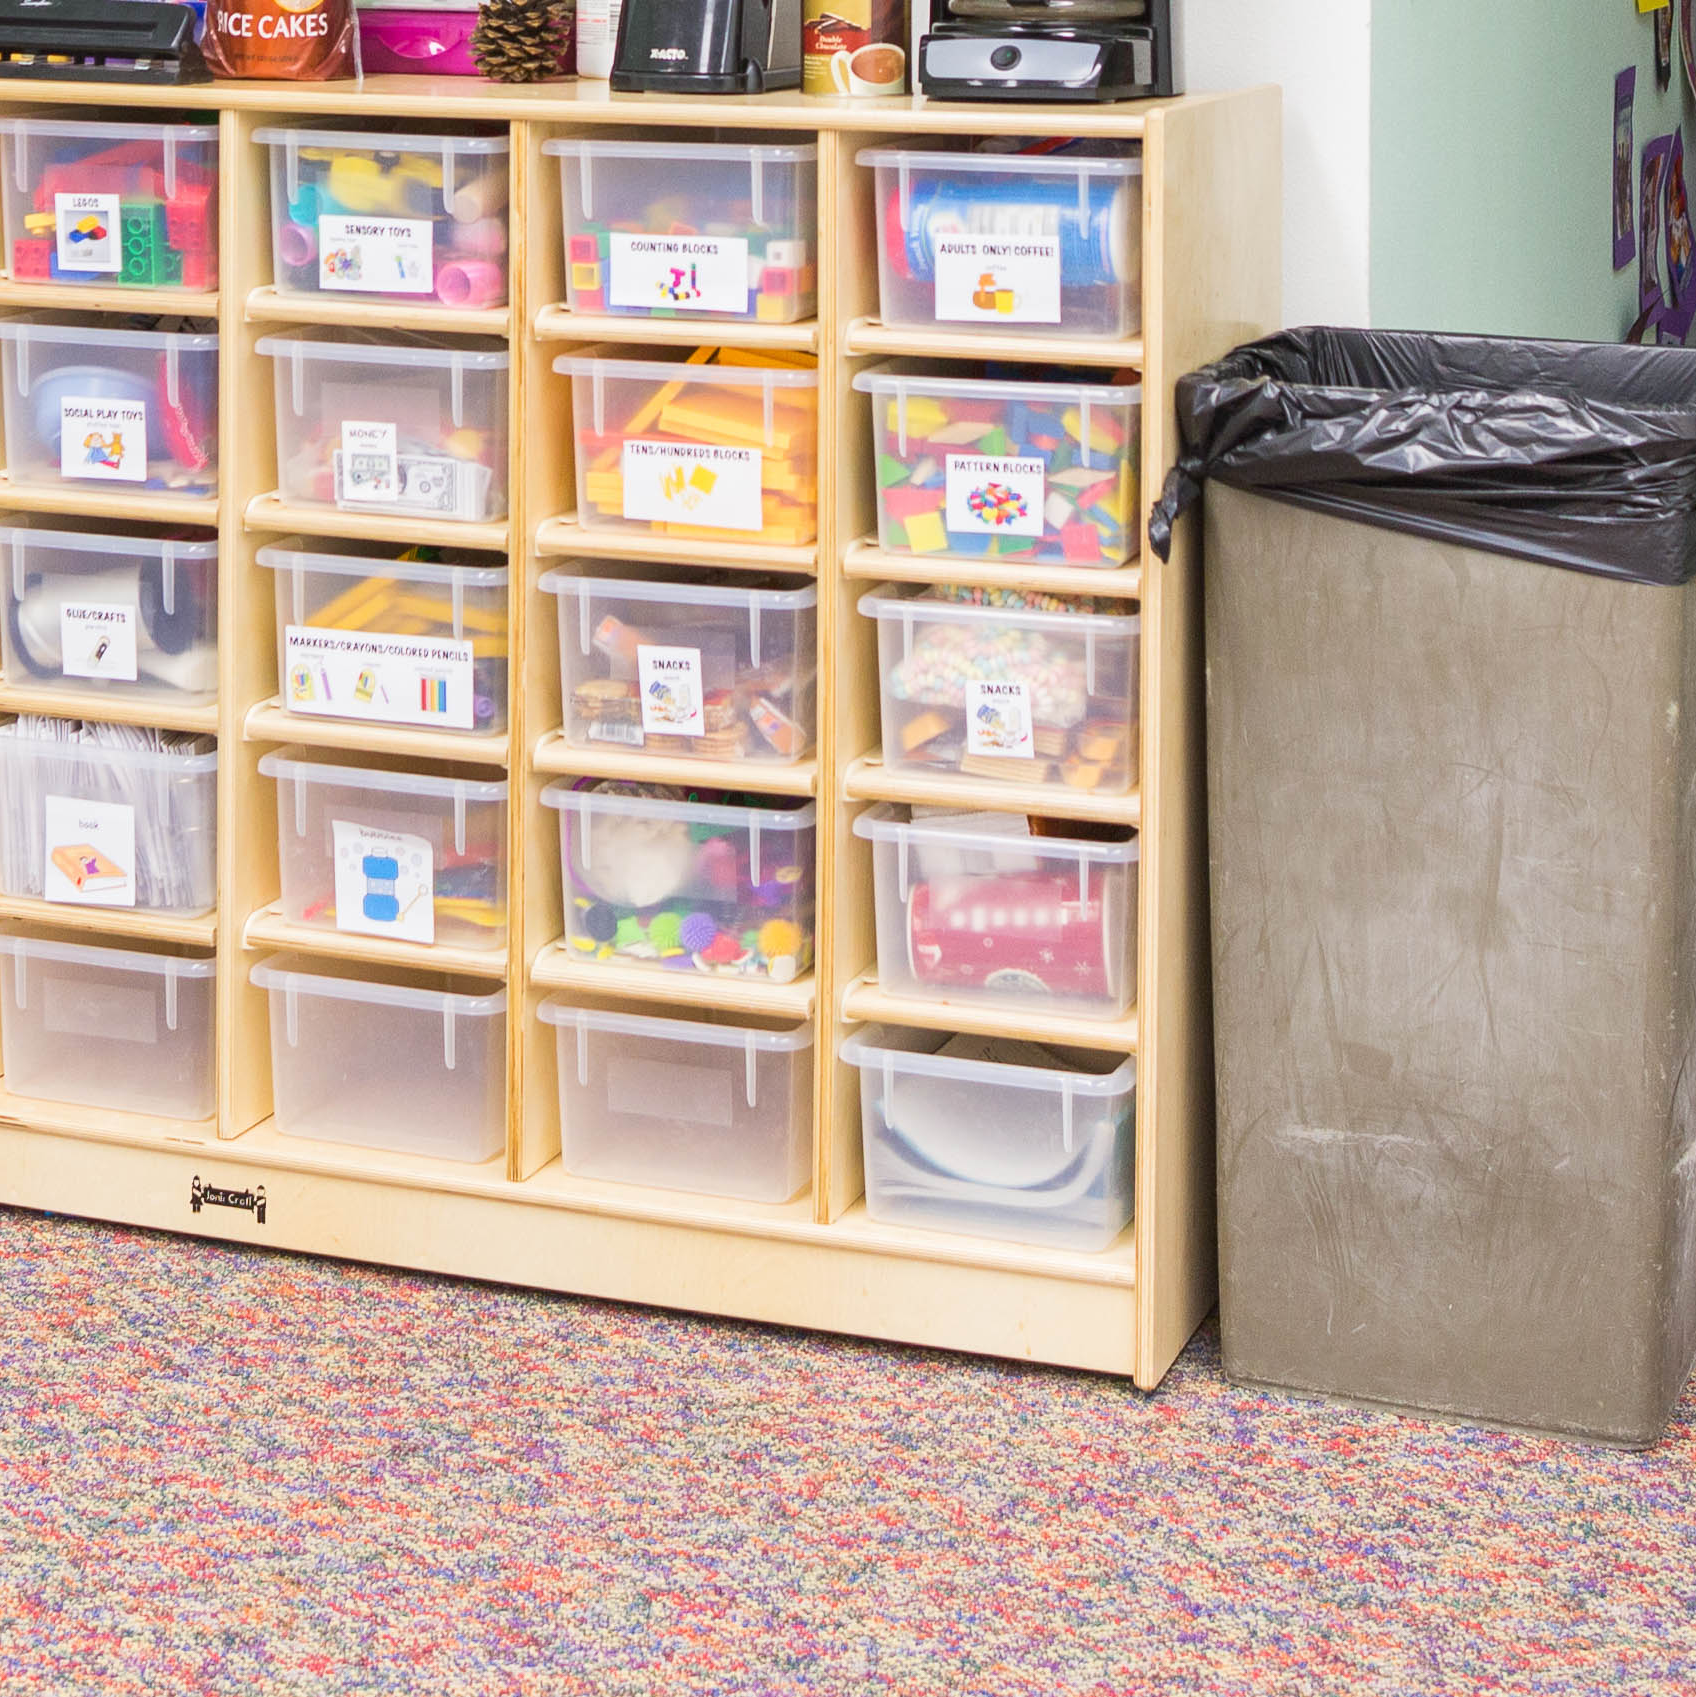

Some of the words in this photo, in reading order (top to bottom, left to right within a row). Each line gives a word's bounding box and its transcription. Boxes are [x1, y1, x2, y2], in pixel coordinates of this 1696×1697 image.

[217, 10, 253, 37] RICE
[258, 13, 328, 39] CAKES
[819, 35, 842, 43] Double
[72, 197, 99, 209] LEGOS
[344, 224, 385, 238] SENSORY
[388, 226, 412, 239] TOYS
[630, 241, 679, 254] COUNTING
[681, 244, 719, 256] BLOCKS
[941, 244, 976, 255] ADULTS
[64, 407, 94, 420] SOCIAL
[96, 408, 118, 421] PLAY
[120, 409, 143, 422] TOYS
[349, 429, 388, 440] MONEY
[630, 444, 705, 460] TENS/HUNDREDS
[707, 448, 751, 462] BLOCKS
[953, 462, 999, 474] PATTERN
[1001, 463, 1043, 475] BLOCKS
[66, 608, 127, 624] GLUE/CRAFTS
[431, 651, 468, 662] PENCILS
[651, 660, 691, 672] SNACKS
[979, 684, 1022, 696] SNACKS
[79, 819, 99, 830] book
